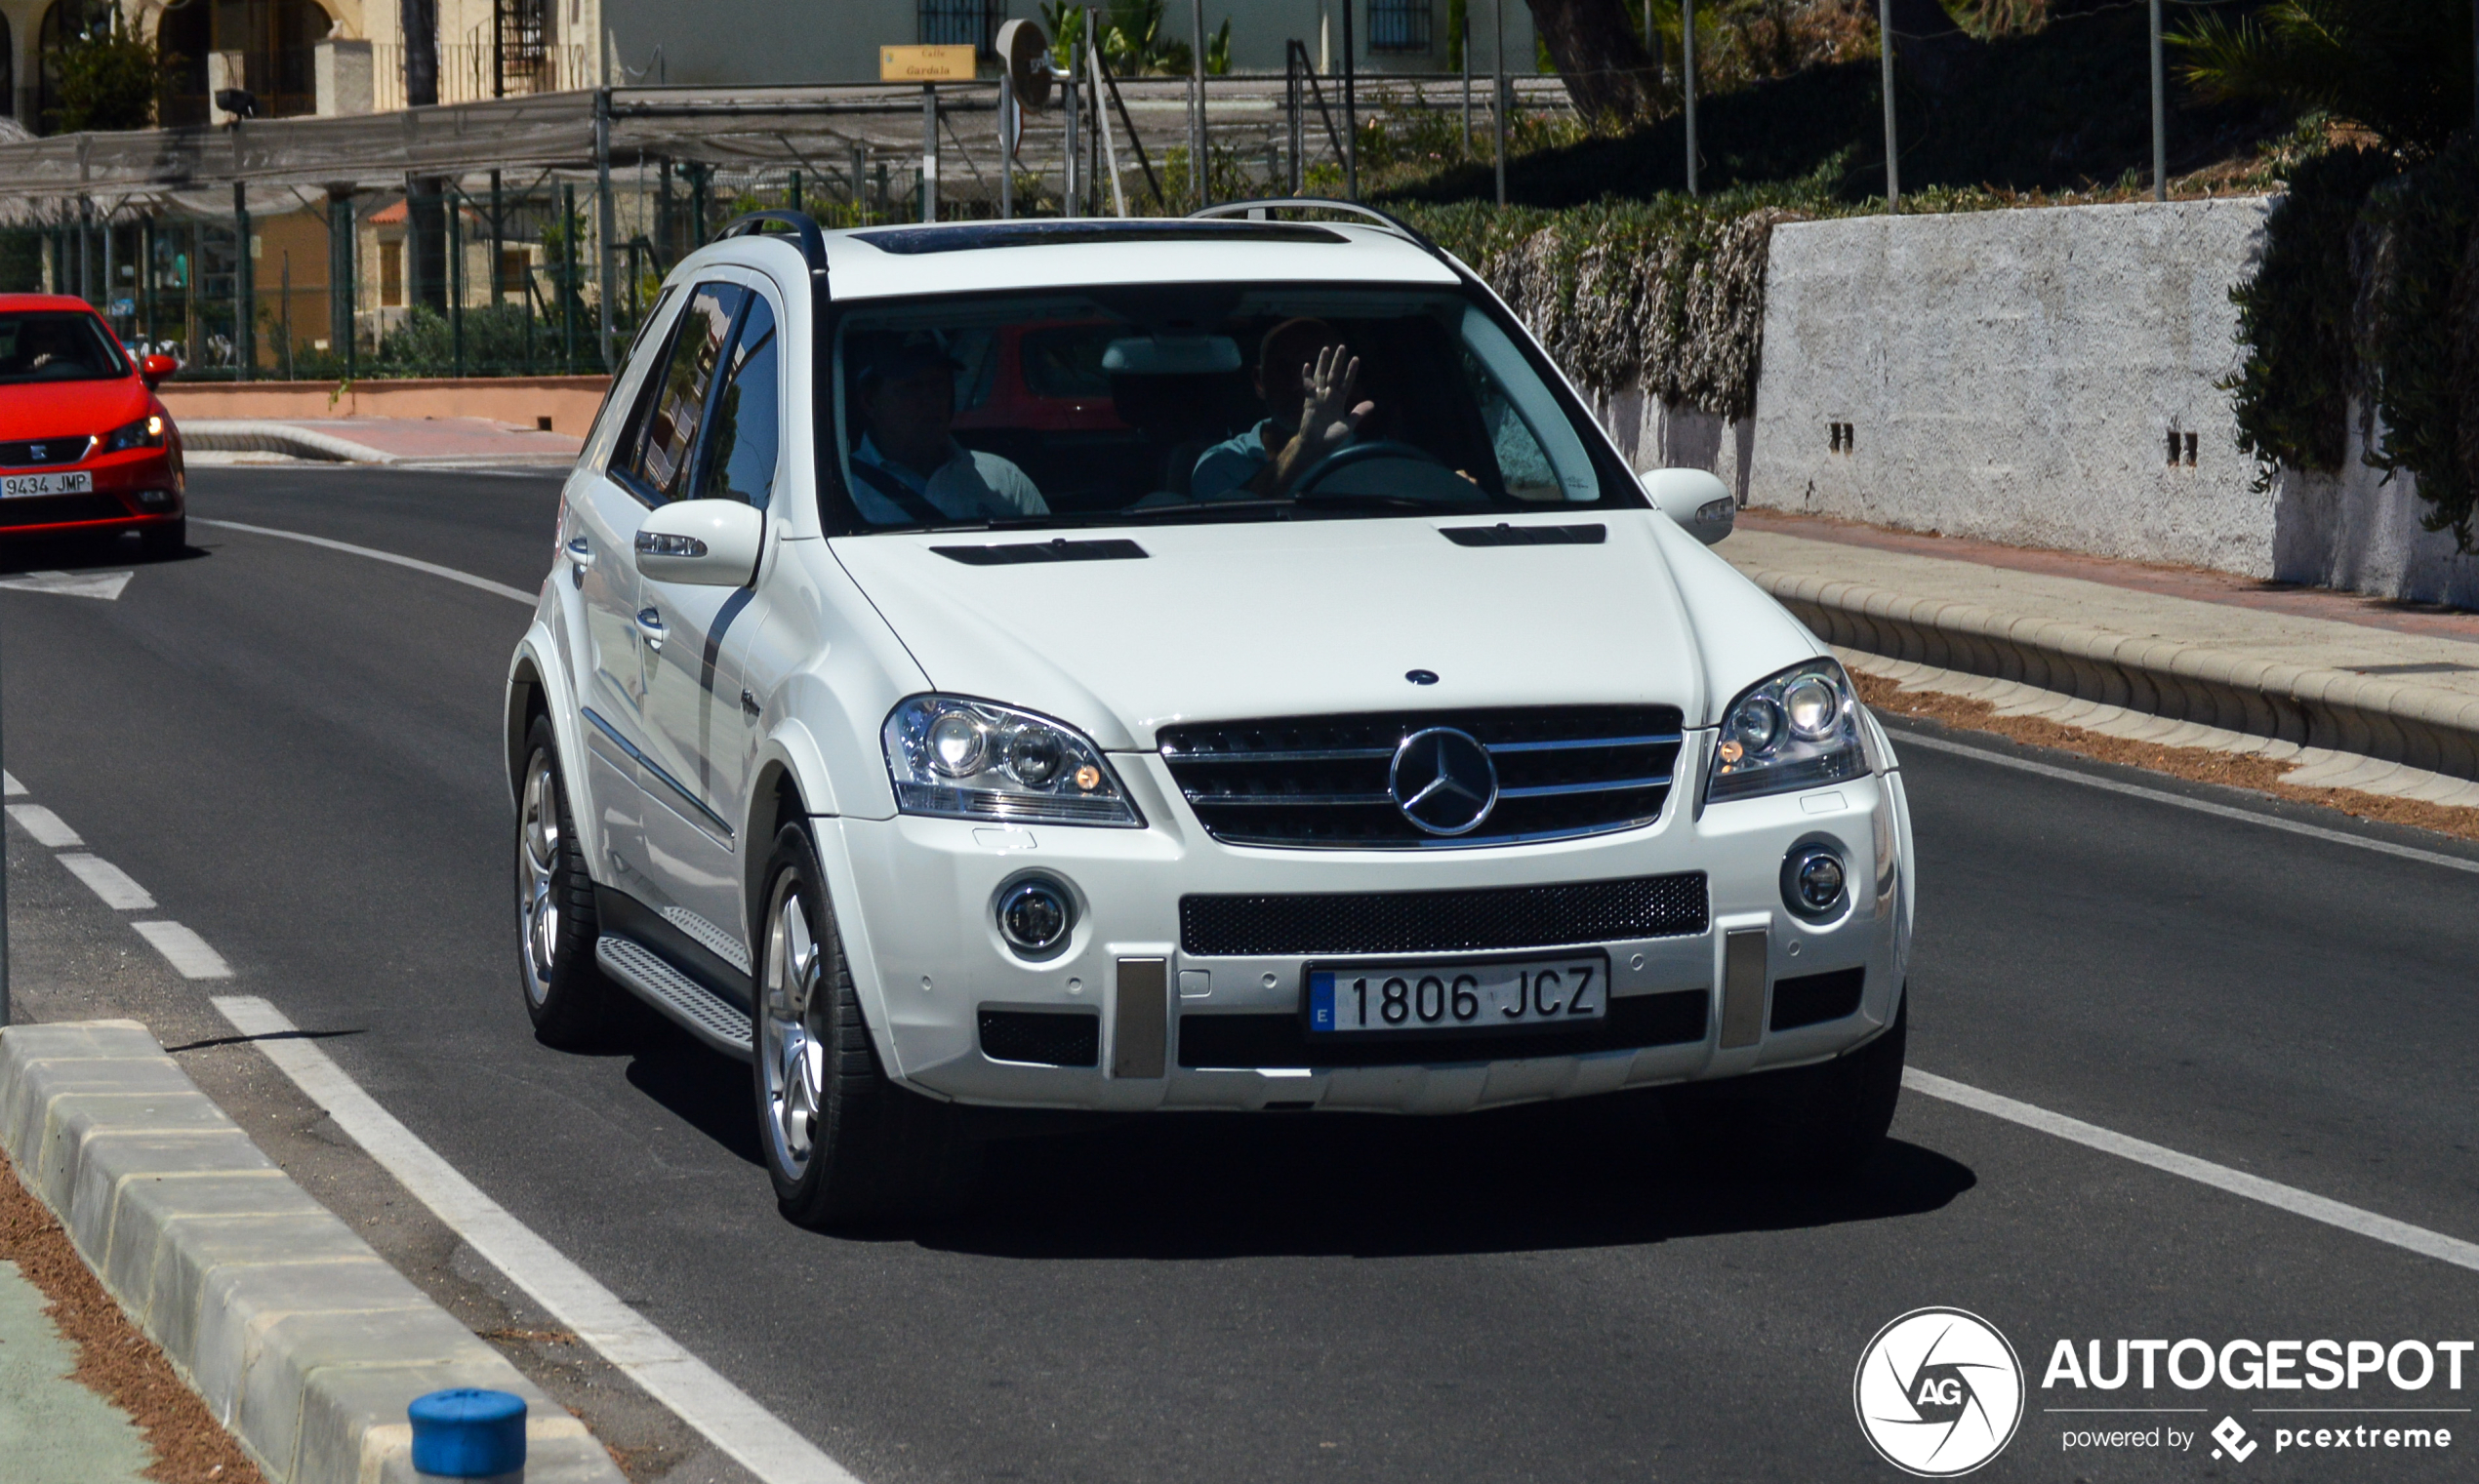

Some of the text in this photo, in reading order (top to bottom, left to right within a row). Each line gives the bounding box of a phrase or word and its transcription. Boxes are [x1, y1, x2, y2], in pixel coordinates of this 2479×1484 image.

[921, 48, 946, 58] Calle
[6, 474, 87, 495] 9434 JMP
[1353, 966, 1594, 1027] 1806 JCZ
[1317, 1009, 1328, 1023] E
